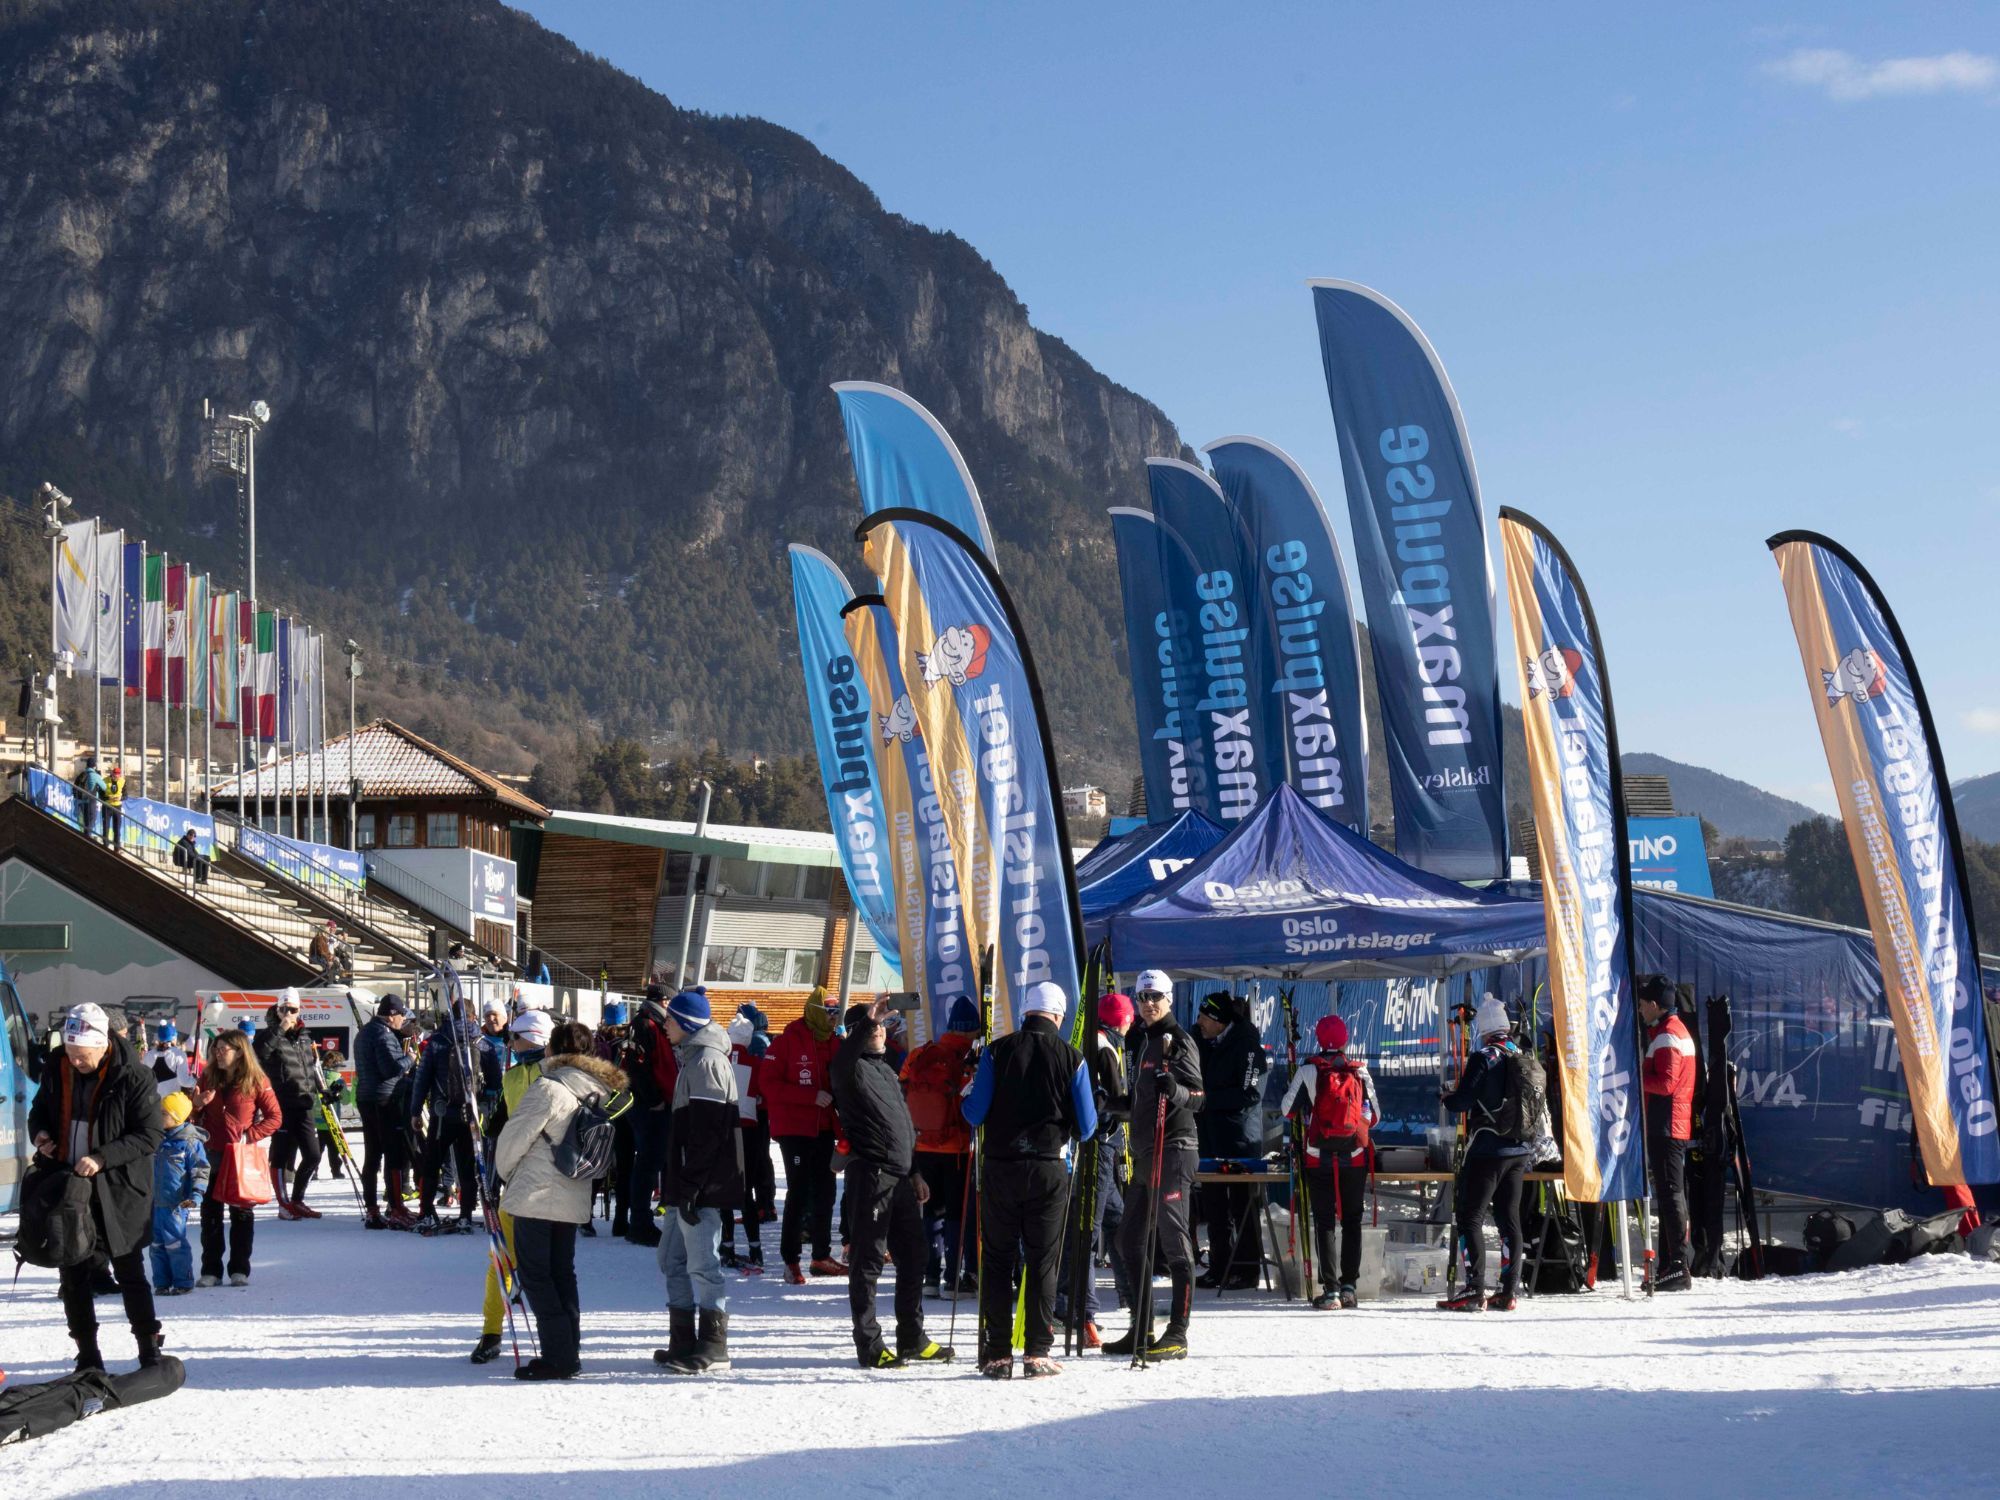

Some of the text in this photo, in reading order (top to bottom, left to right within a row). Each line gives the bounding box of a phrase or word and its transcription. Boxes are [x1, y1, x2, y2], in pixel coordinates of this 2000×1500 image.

[1204, 880, 1304, 901] Oslo
[1282, 916, 1338, 937] Oslo
[1284, 931, 1436, 956] Sportslager
